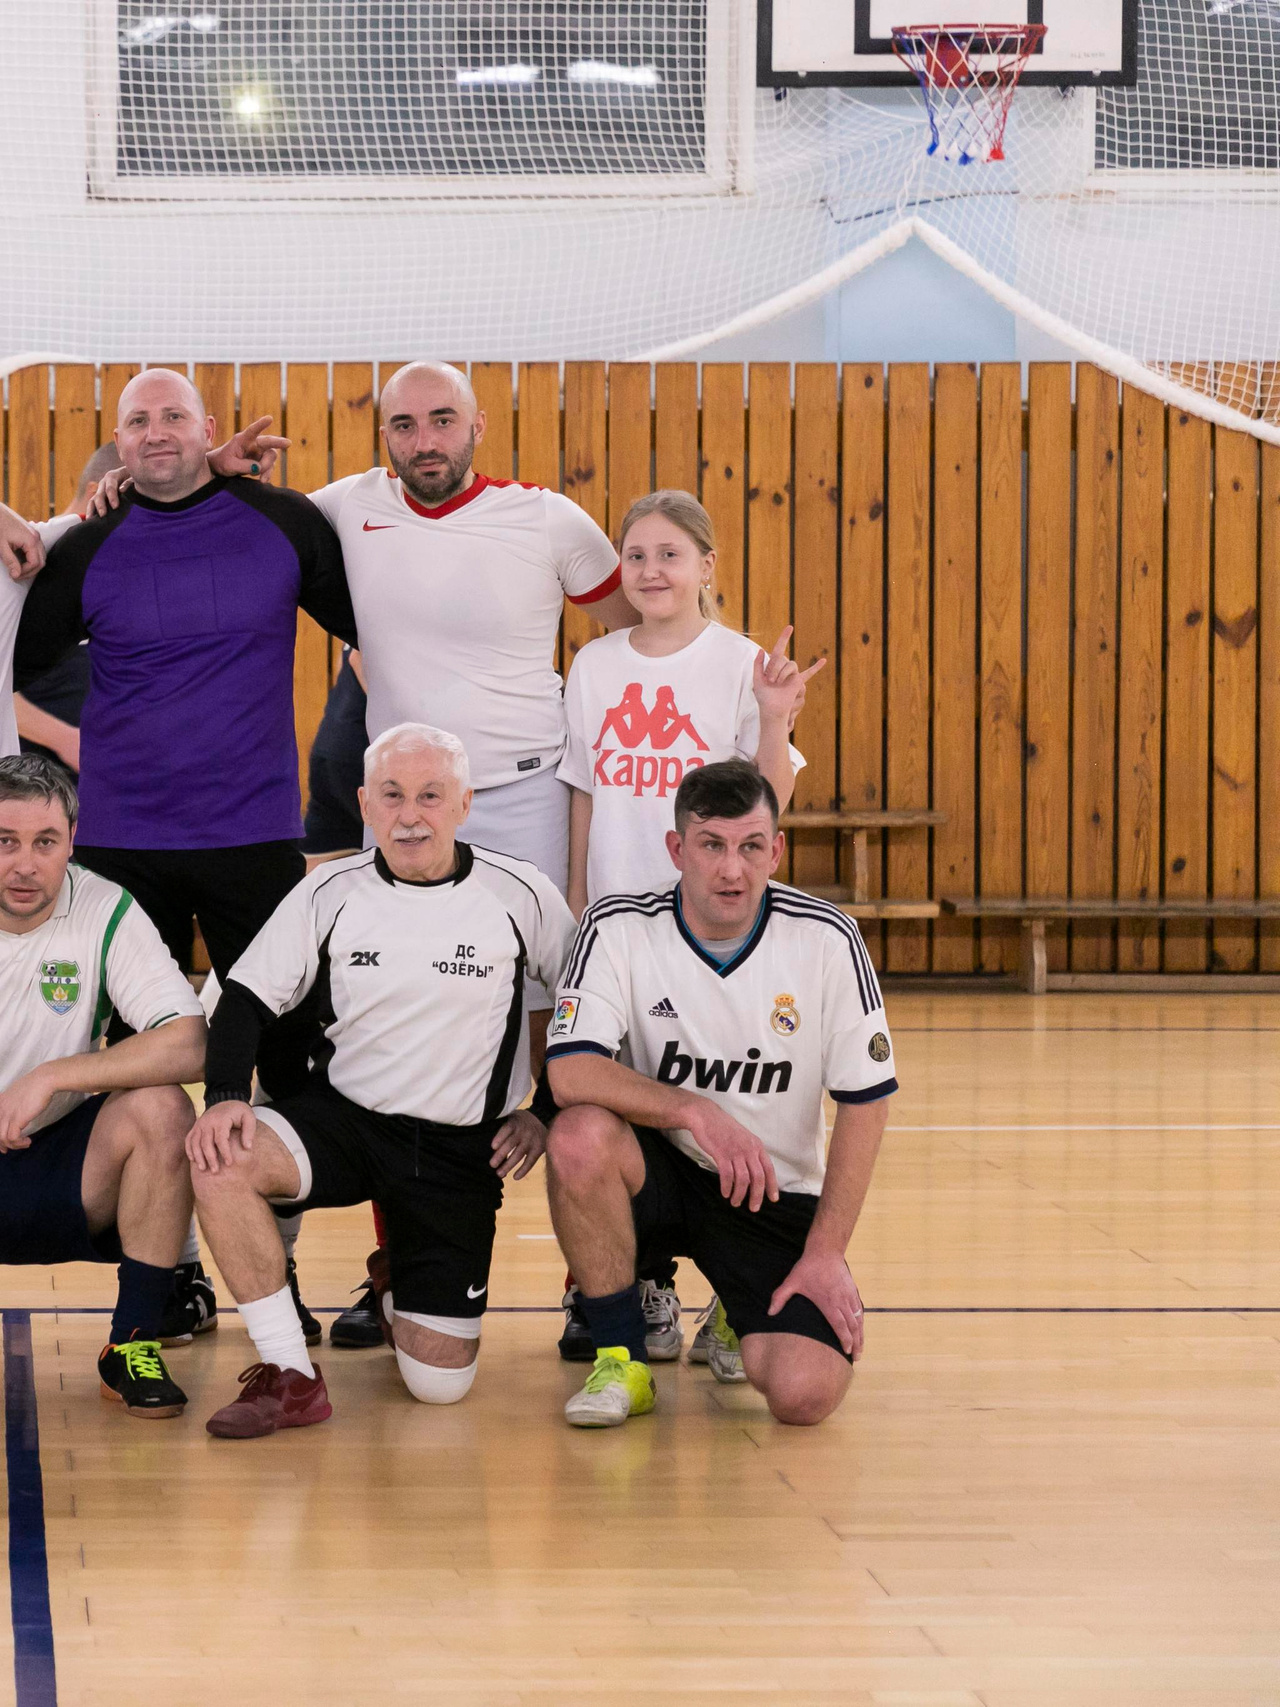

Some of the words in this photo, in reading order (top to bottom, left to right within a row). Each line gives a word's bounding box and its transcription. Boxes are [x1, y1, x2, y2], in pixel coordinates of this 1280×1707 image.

[348, 951, 381, 967] 2K
[455, 944, 476, 959] ДС
[648, 1009, 679, 1019] adidas
[657, 1040, 793, 1094] bwin
